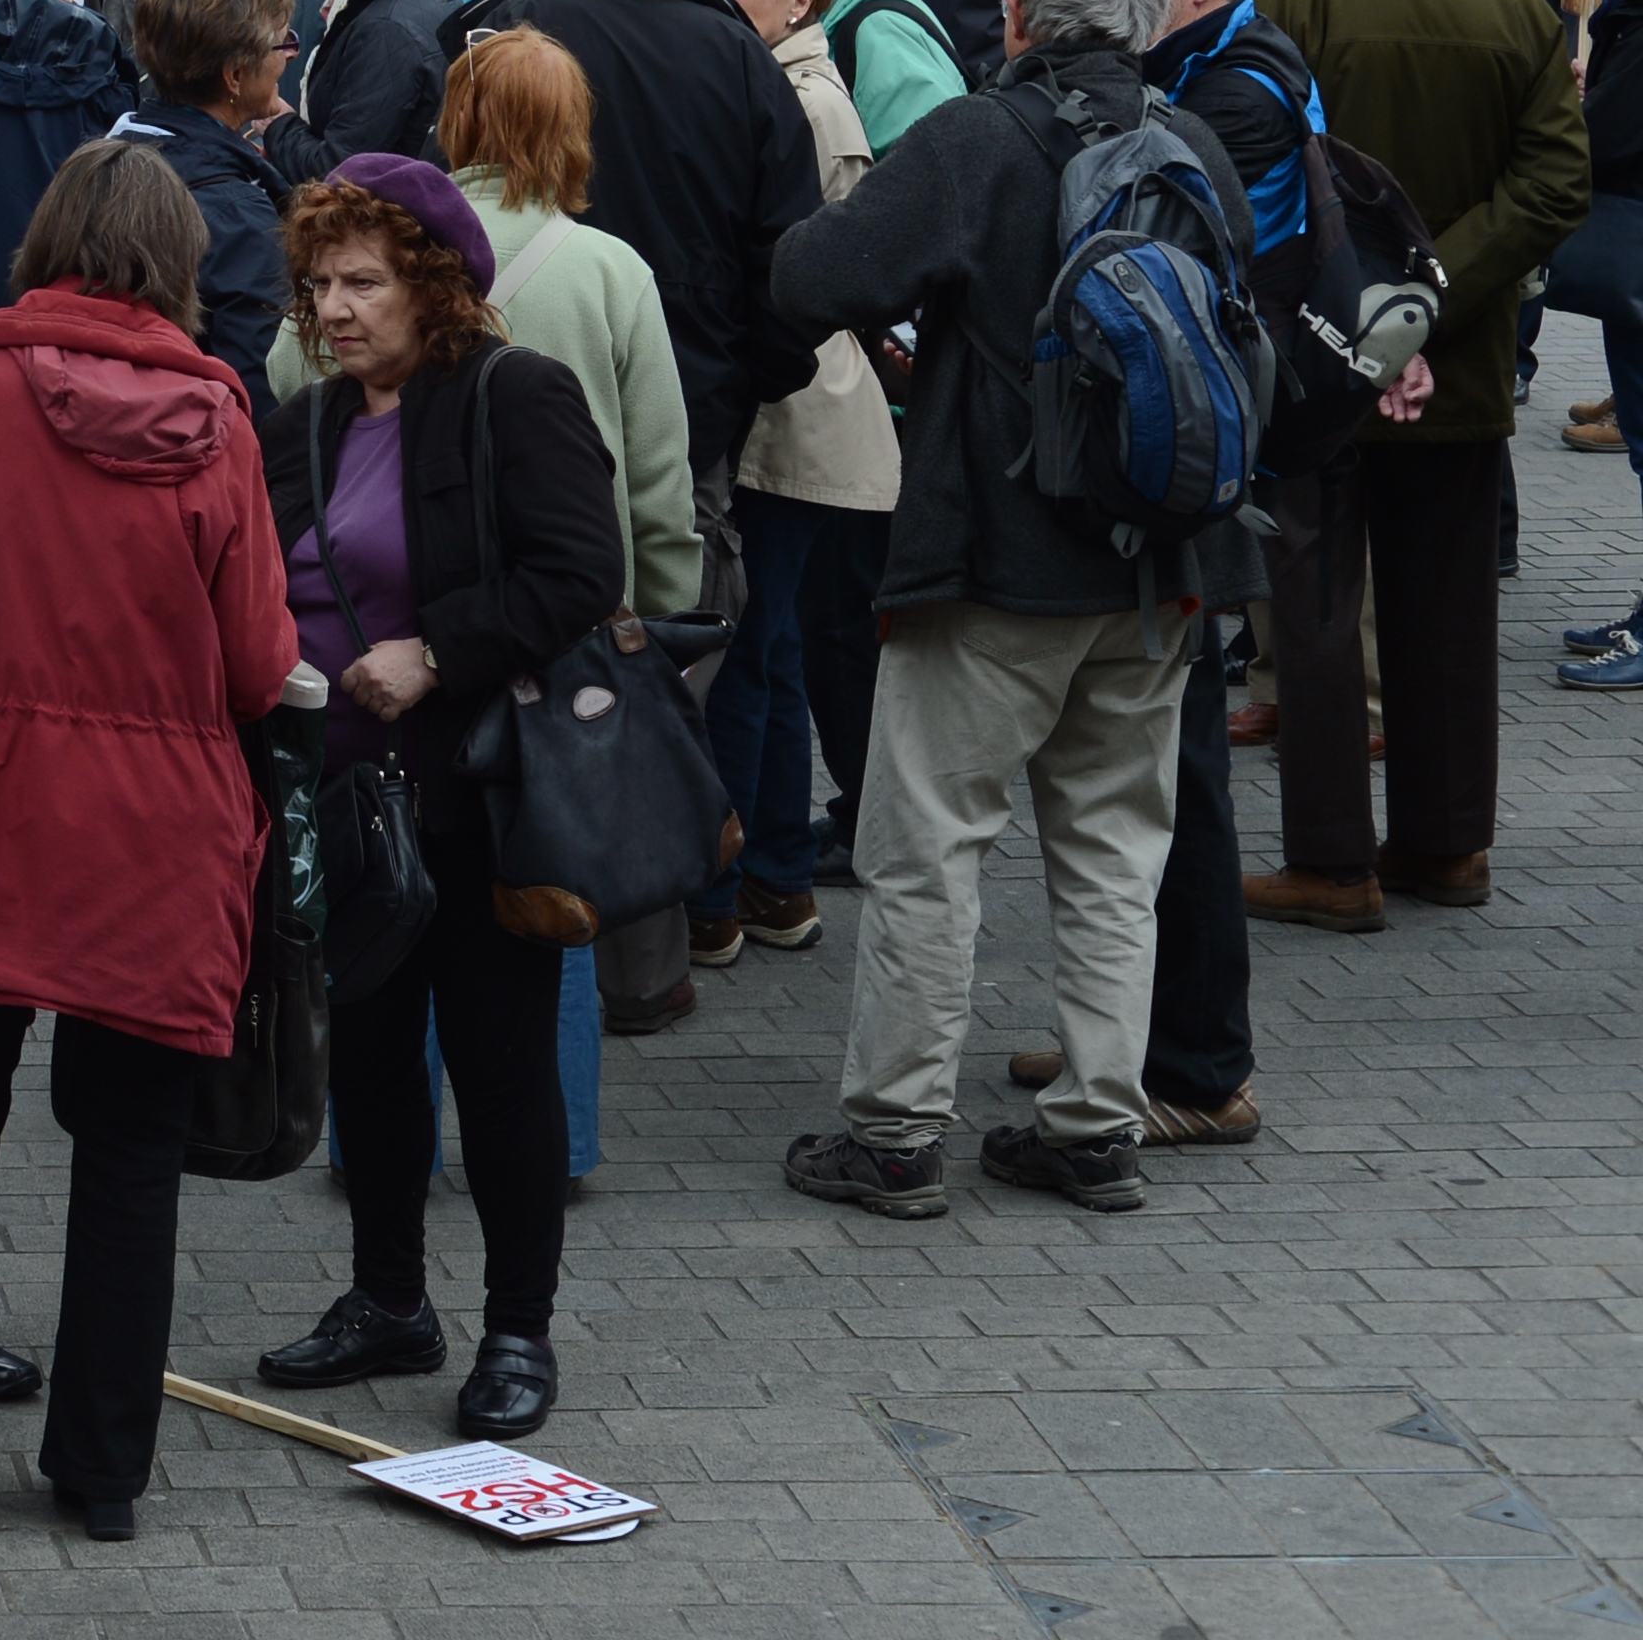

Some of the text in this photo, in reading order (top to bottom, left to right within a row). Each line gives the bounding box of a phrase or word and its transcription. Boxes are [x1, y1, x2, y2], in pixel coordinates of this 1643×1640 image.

[1297, 301, 1382, 380] HEAD
[436, 1472, 602, 1512] HS2
[497, 1493, 630, 1527] STOP
